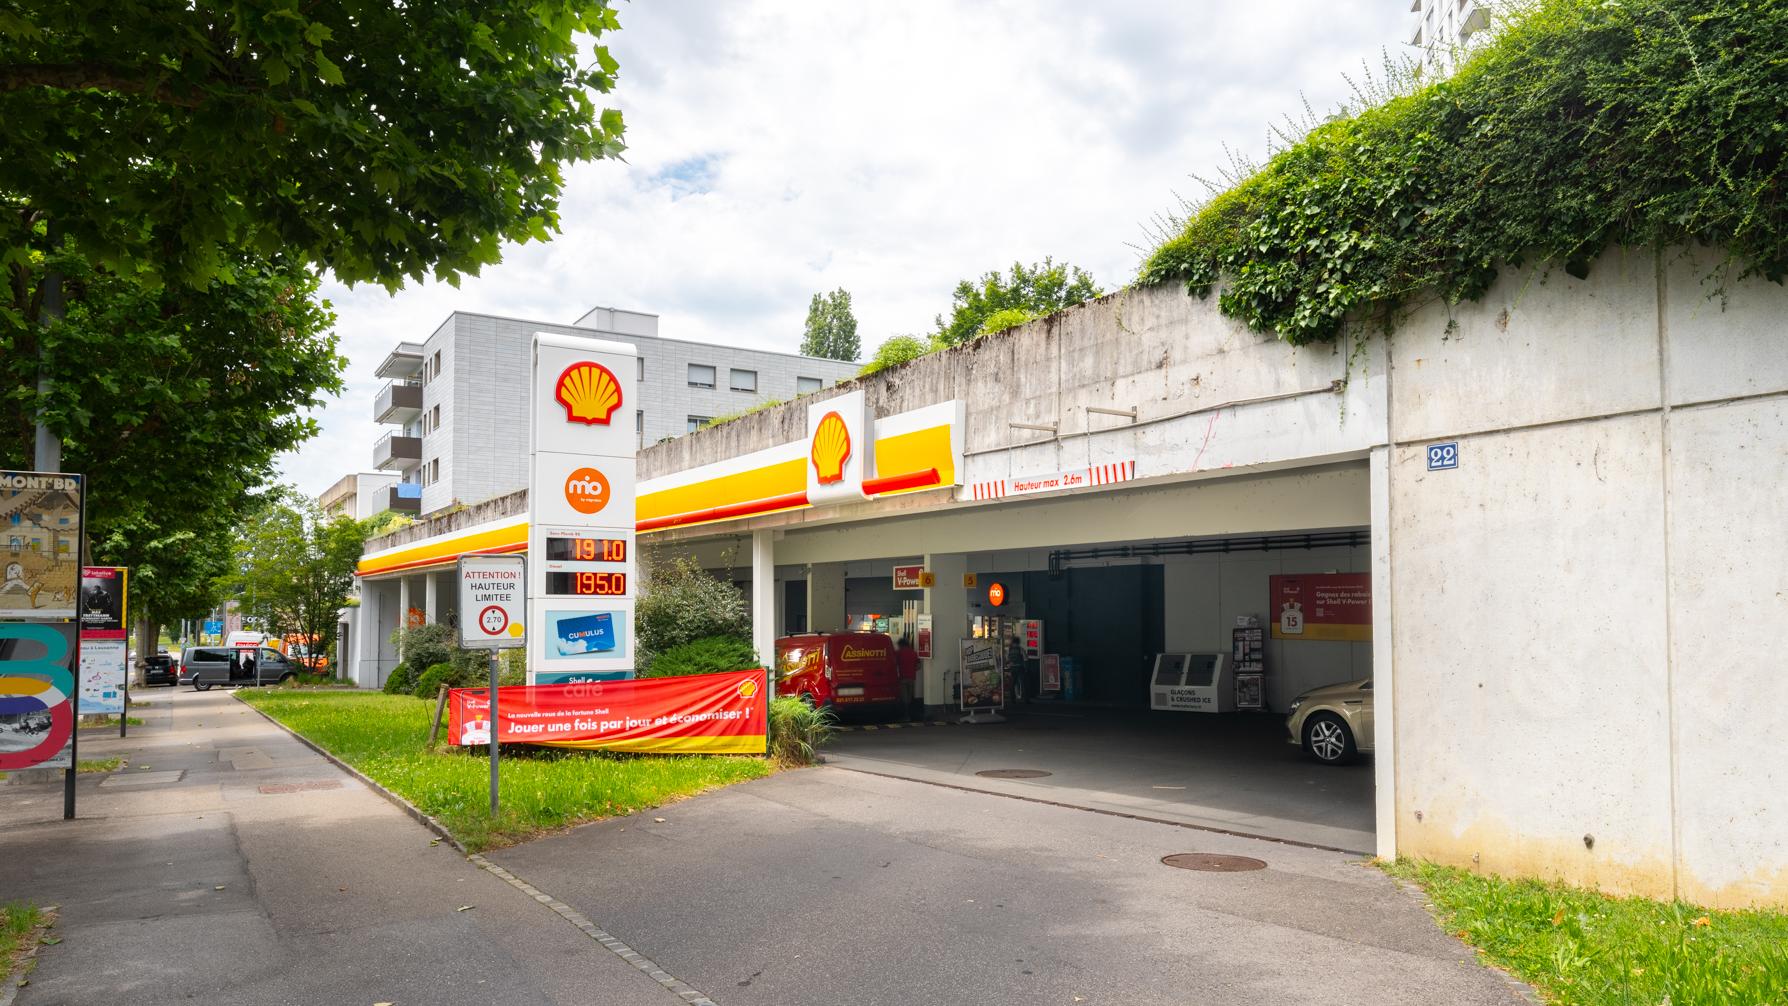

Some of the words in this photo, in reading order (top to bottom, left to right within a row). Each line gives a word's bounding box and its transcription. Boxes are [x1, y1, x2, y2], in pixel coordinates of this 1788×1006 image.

[1430, 446, 1455, 467] 22
[568, 475, 603, 496] mio
[1014, 479, 1041, 492] Hauteur
[1042, 479, 1060, 488] max
[1063, 473, 1083, 486] 2.6m
[575, 538, 624, 561] 191.0
[464, 571, 516, 580] ATTENTION
[925, 576, 931, 585] 6
[967, 576, 974, 585] 5
[470, 582, 516, 591] HAUTEUR
[575, 572, 624, 594] 195.0
[990, 587, 1001, 597] mio
[475, 593, 512, 602] LIMITEE
[486, 616, 502, 624] 2.70
[1286, 616, 1298, 627] 15
[568, 628, 604, 640] CUMULUS
[568, 676, 586, 684] Shell
[1170, 689, 1196, 697] GLAÇONS
[516, 711, 541, 719] nouvelle
[572, 709, 594, 717] fortune
[507, 721, 545, 734] Jouer
[547, 723, 572, 733] une
[574, 718, 598, 731] fois
[600, 719, 623, 733] par
[625, 717, 652, 731] jour
[654, 716, 668, 726] et
[668, 708, 743, 725] économiser
